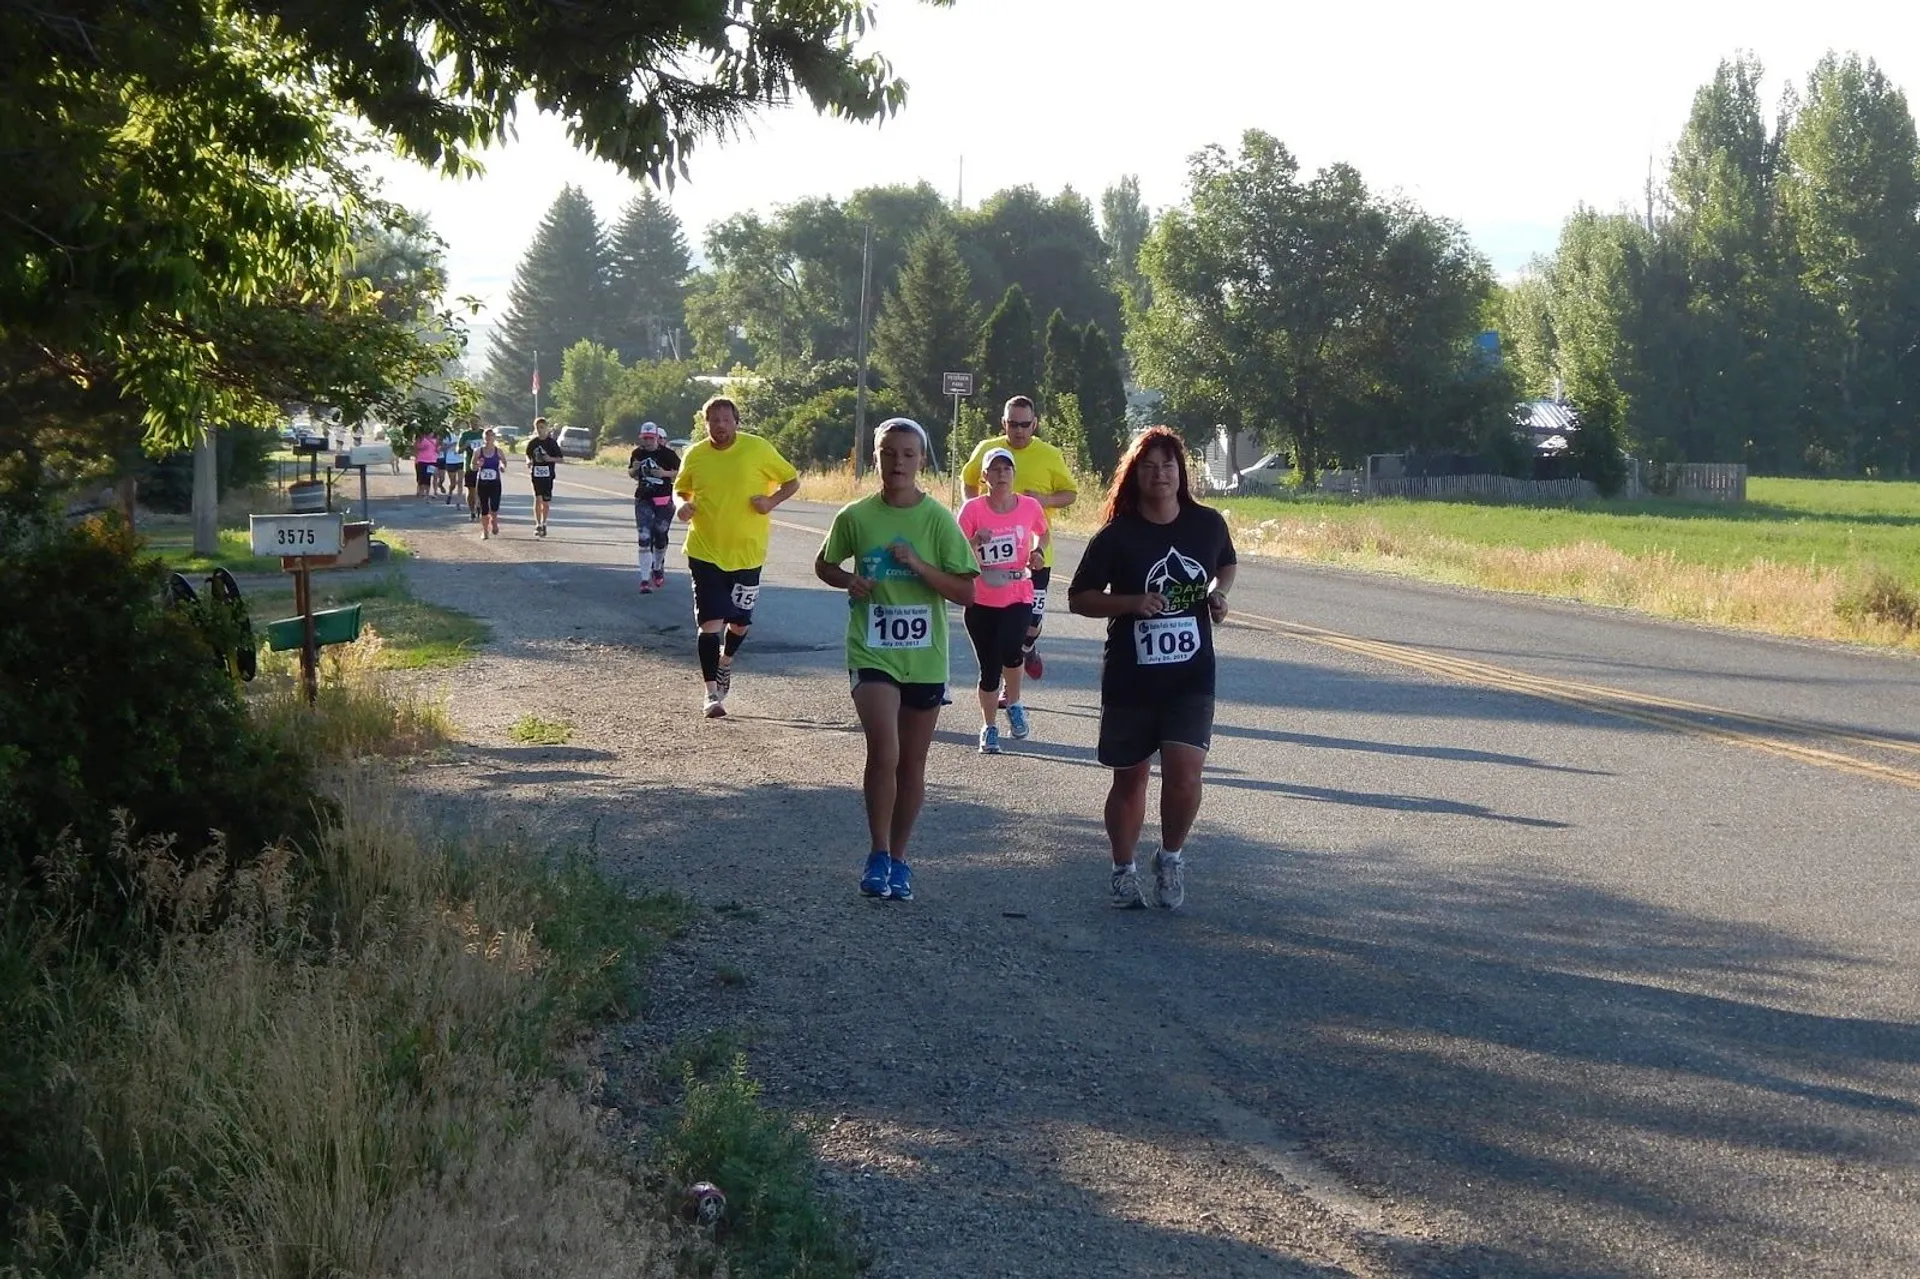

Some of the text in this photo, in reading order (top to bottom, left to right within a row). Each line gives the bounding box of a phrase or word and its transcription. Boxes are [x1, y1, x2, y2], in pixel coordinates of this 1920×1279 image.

[278, 529, 315, 546] 3575
[977, 543, 1013, 561] 119
[874, 617, 927, 640] 109
[1140, 630, 1195, 656] 108
